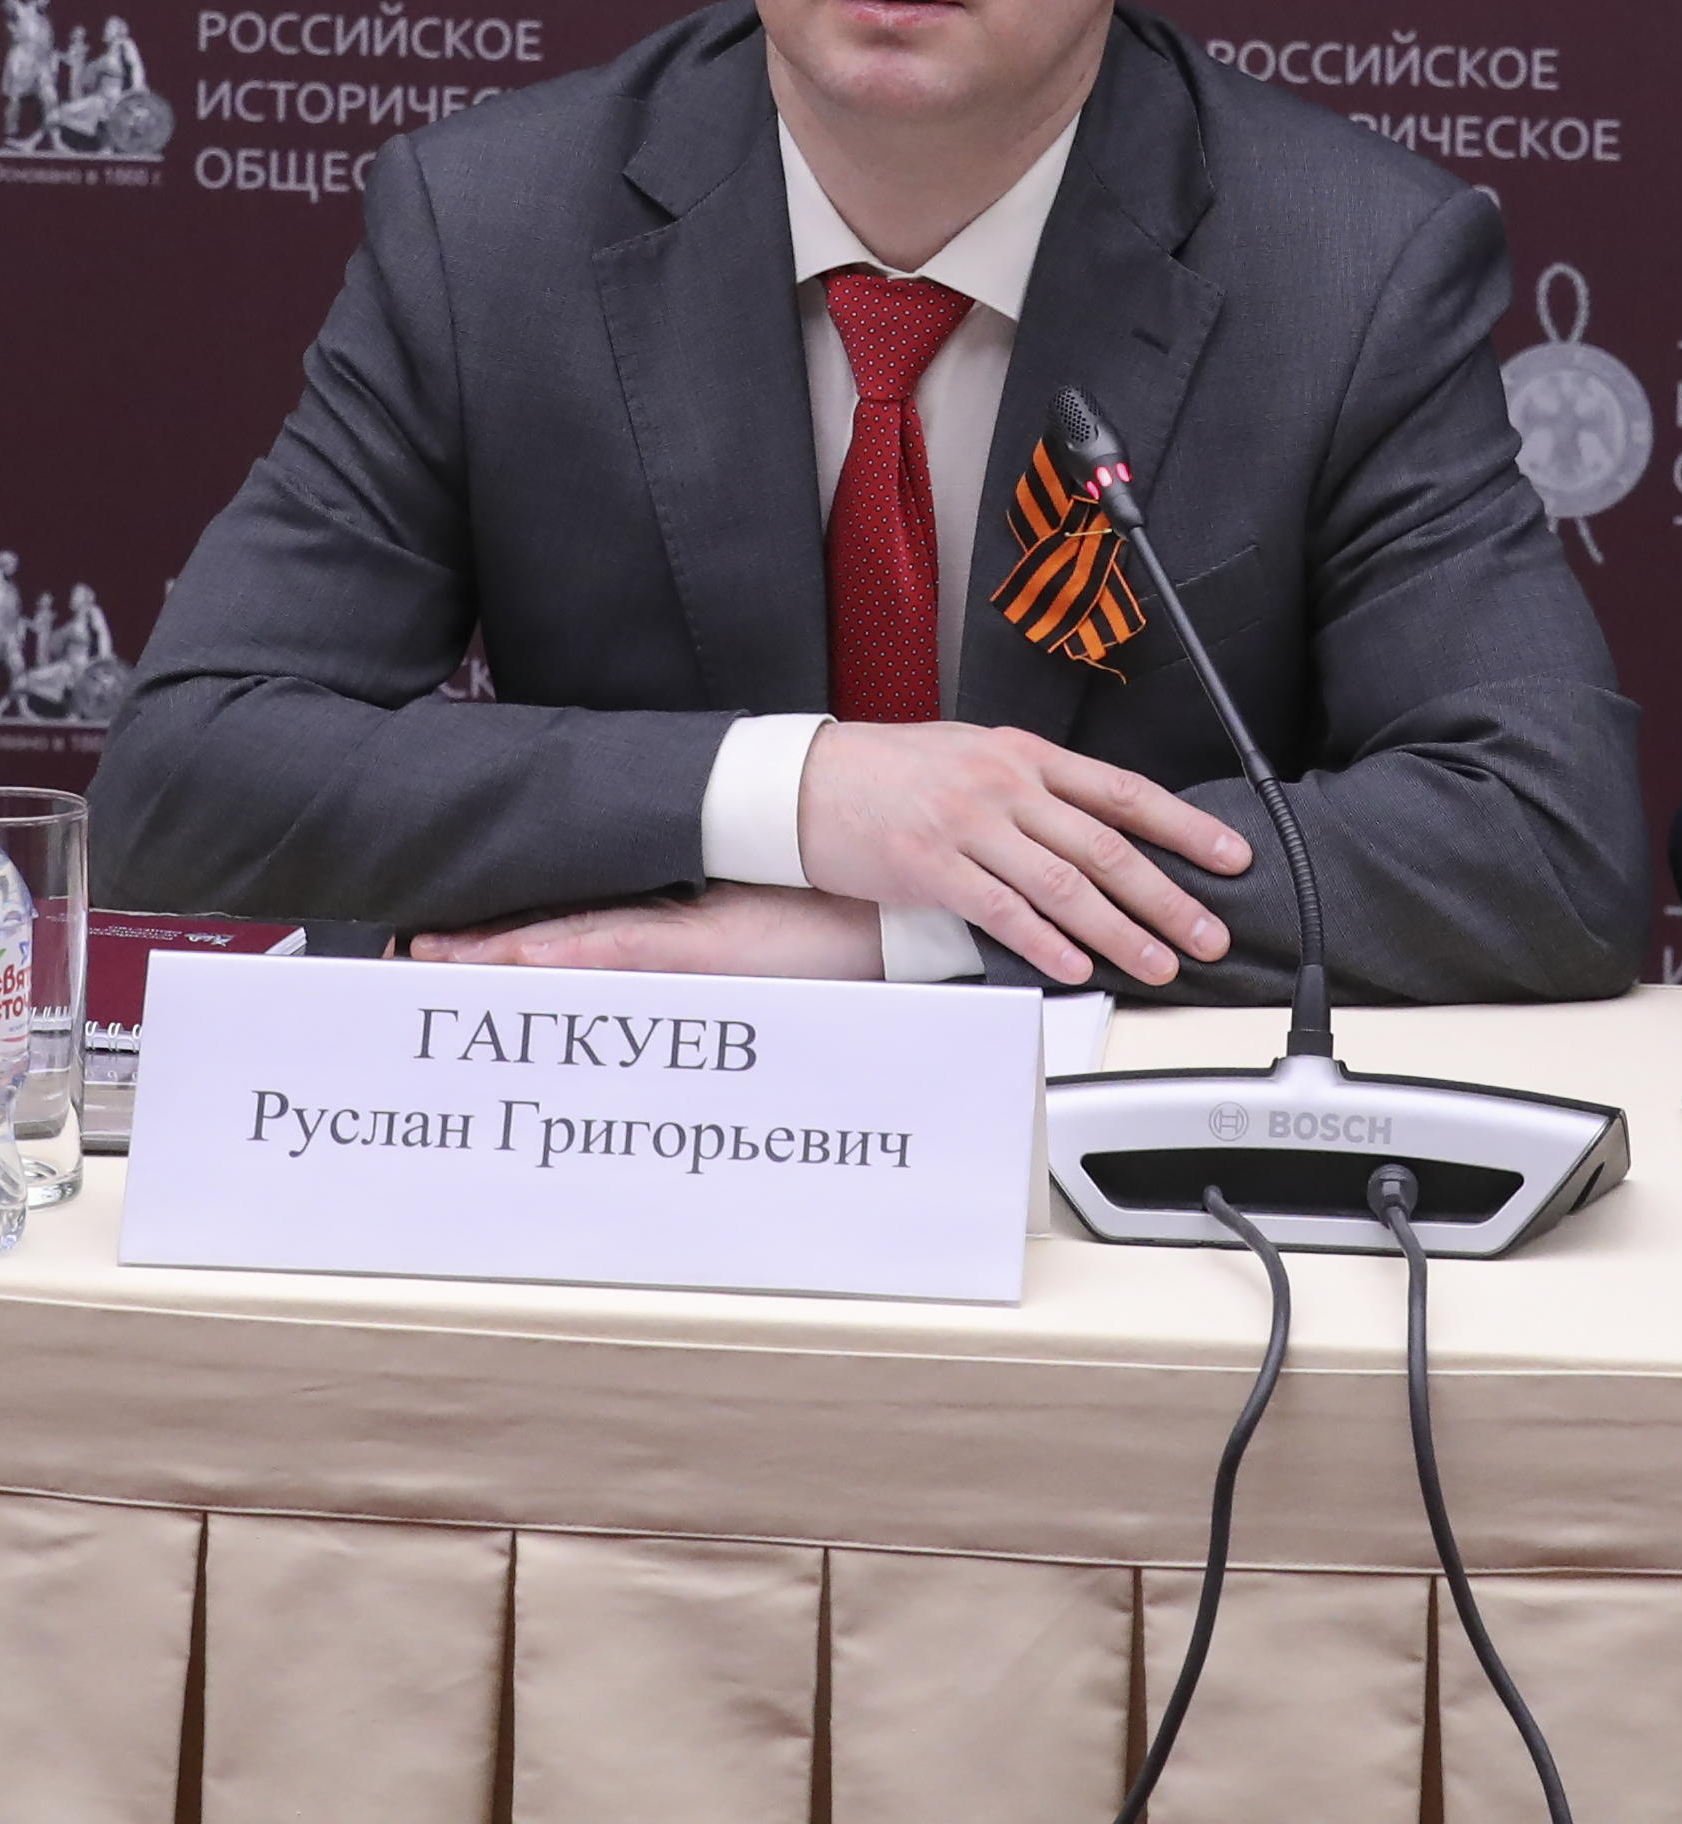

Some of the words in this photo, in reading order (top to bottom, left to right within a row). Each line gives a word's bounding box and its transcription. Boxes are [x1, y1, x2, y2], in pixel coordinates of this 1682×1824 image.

[198, 2, 541, 61] РОССИЙСКОЕ
[196, 79, 503, 126] ИСТОРИЧЕ
[1349, 111, 1622, 163] ИЧЕСКОЕ
[414, 1009, 758, 1072] ГАГКУЕВ
[248, 1091, 475, 1158] Руслан
[495, 1100, 913, 1175] Григорьевич
[1268, 1110, 1392, 1145] BOSCH
